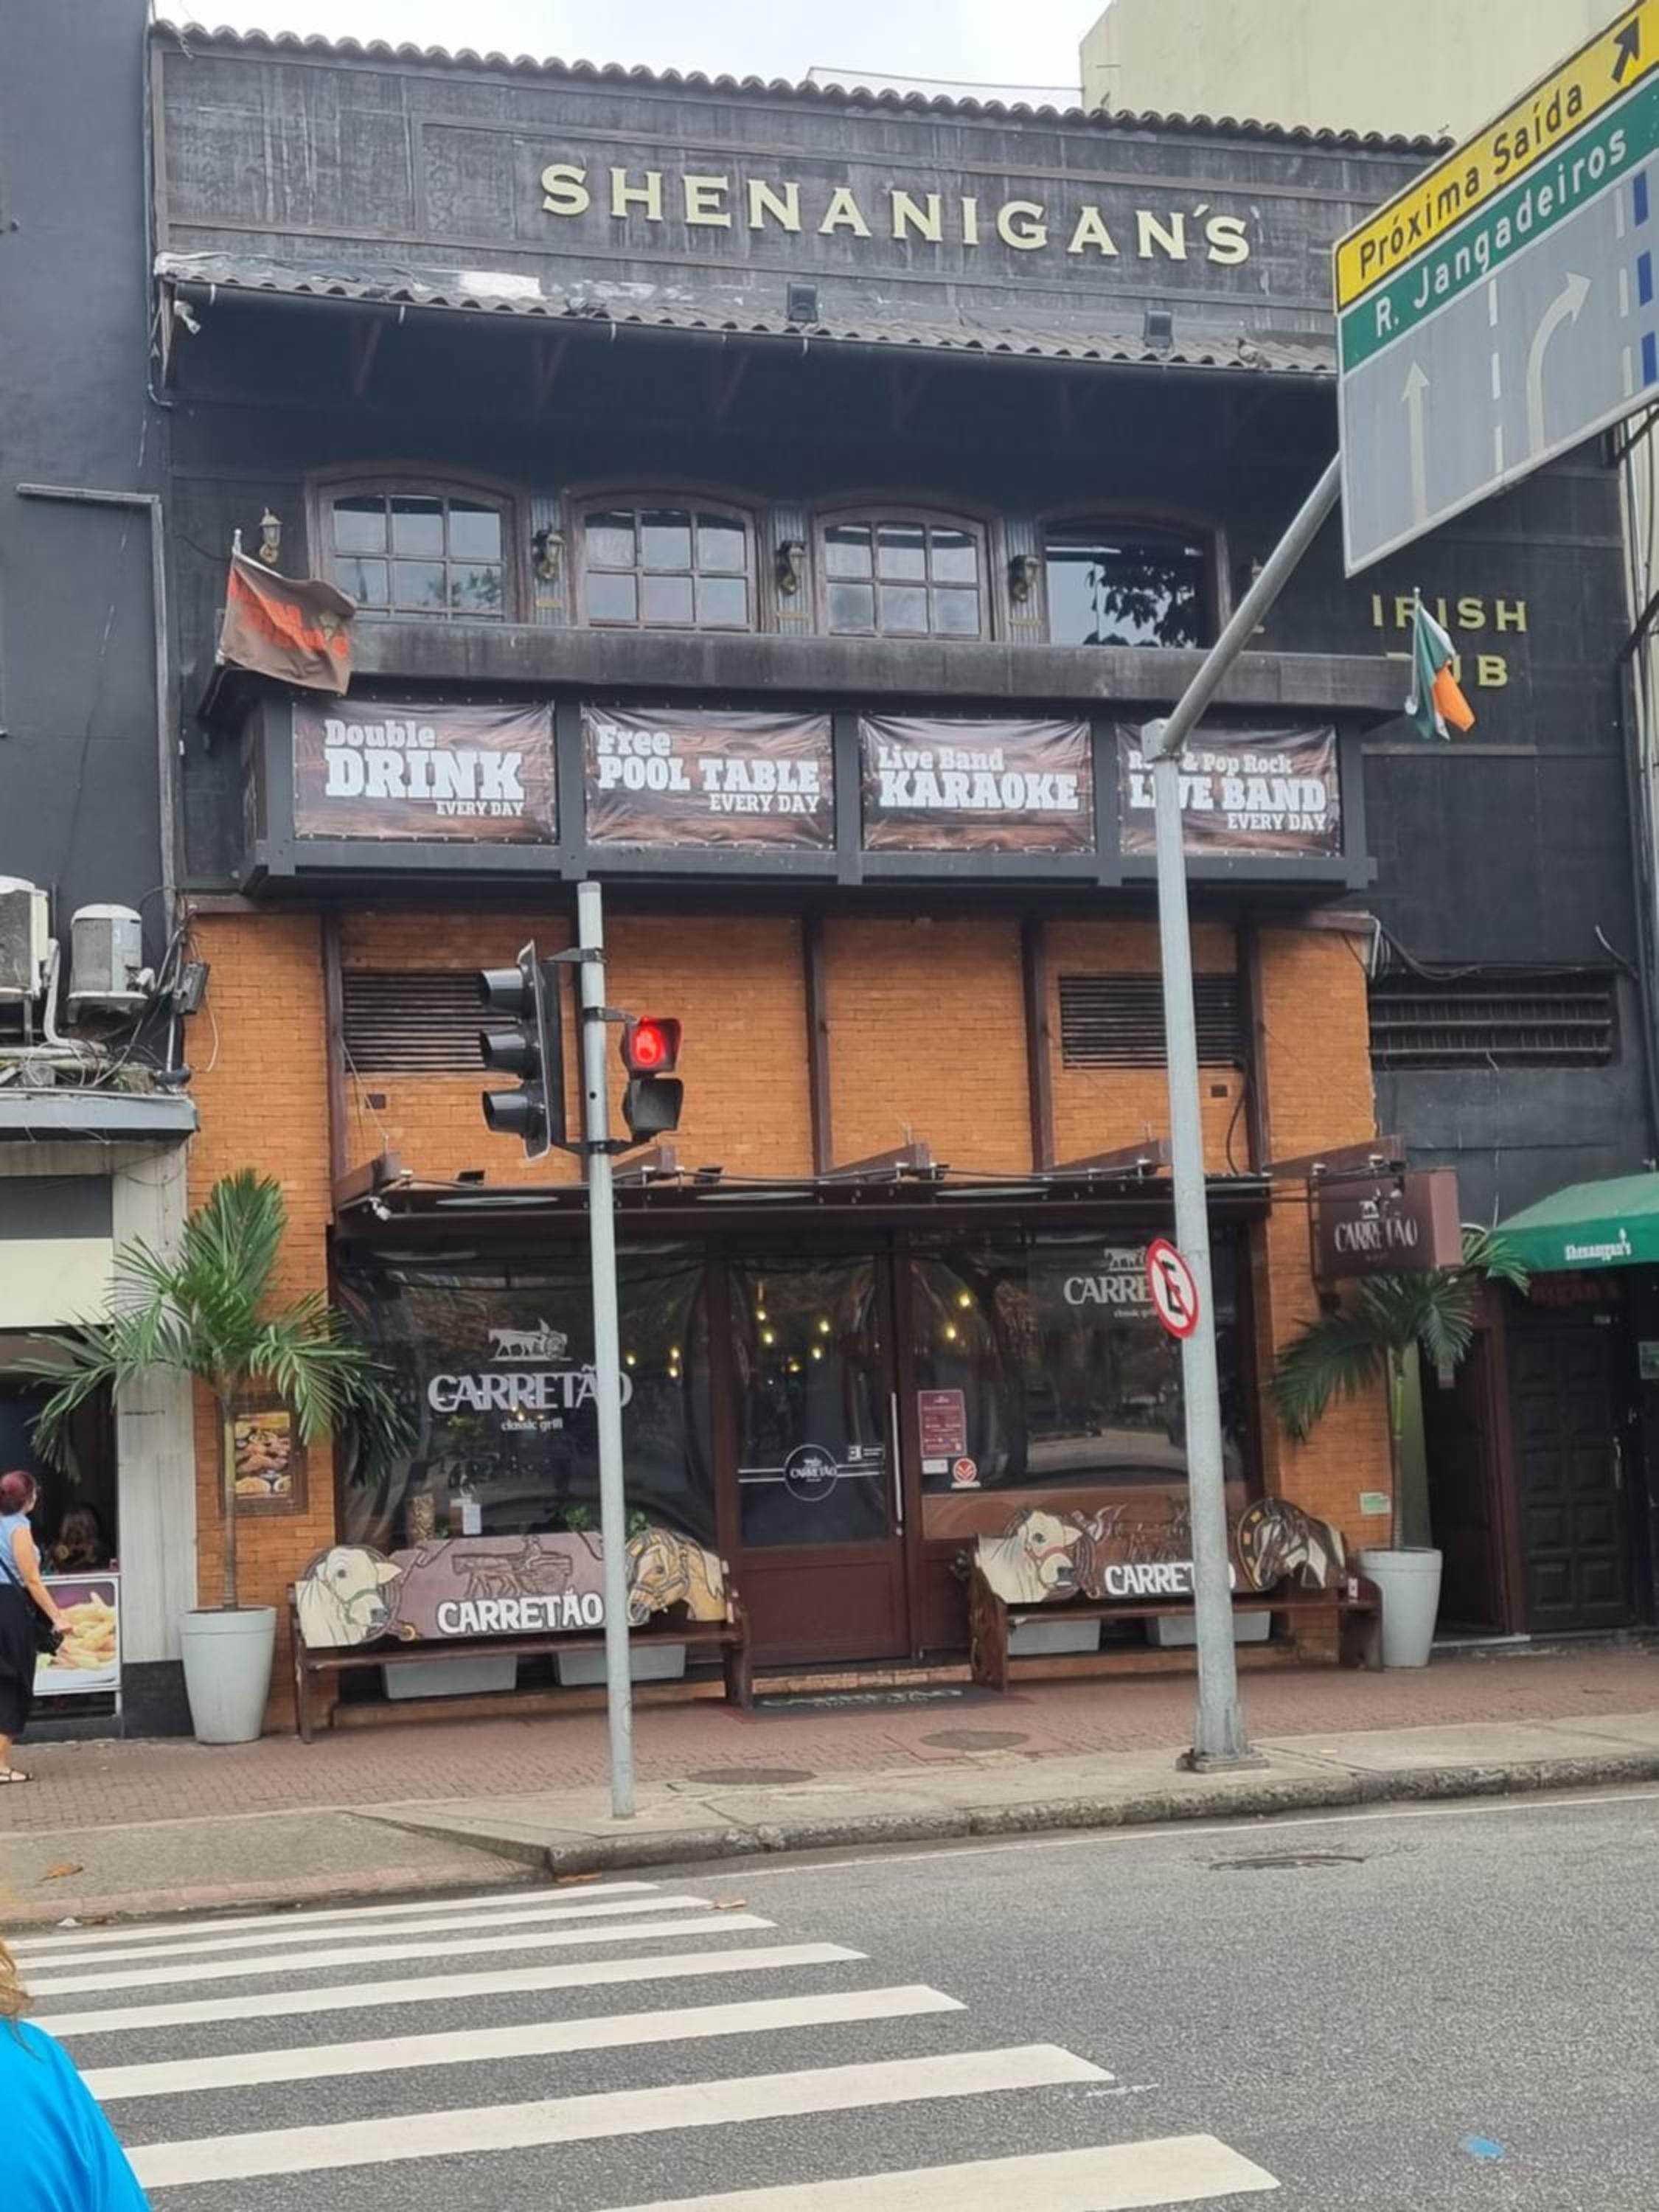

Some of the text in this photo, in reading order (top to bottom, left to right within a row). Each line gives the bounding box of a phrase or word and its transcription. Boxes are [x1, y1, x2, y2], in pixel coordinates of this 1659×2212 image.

[1358, 83, 1582, 279] Próxima Saída
[541, 164, 1250, 265] SHENANIGAN'S
[1376, 129, 1627, 337] R. Jangadeiros
[324, 720, 436, 748] Double
[597, 726, 671, 756] Free
[324, 748, 524, 800] DRINK
[877, 744, 1005, 771] Live Band
[1202, 752, 1239, 776] Pop
[1243, 754, 1292, 774] Rock
[597, 756, 820, 793] POOL TABLE
[878, 771, 1079, 810] KARAOKE
[436, 801, 524, 816] EVERY DAY
[709, 793, 820, 813] EVERY DAY
[1221, 777, 1326, 812] BAND
[1227, 813, 1327, 831] EVERY DAY
[1063, 1274, 1153, 1305] CARRE
[1105, 1561, 1237, 1596] CARRET
